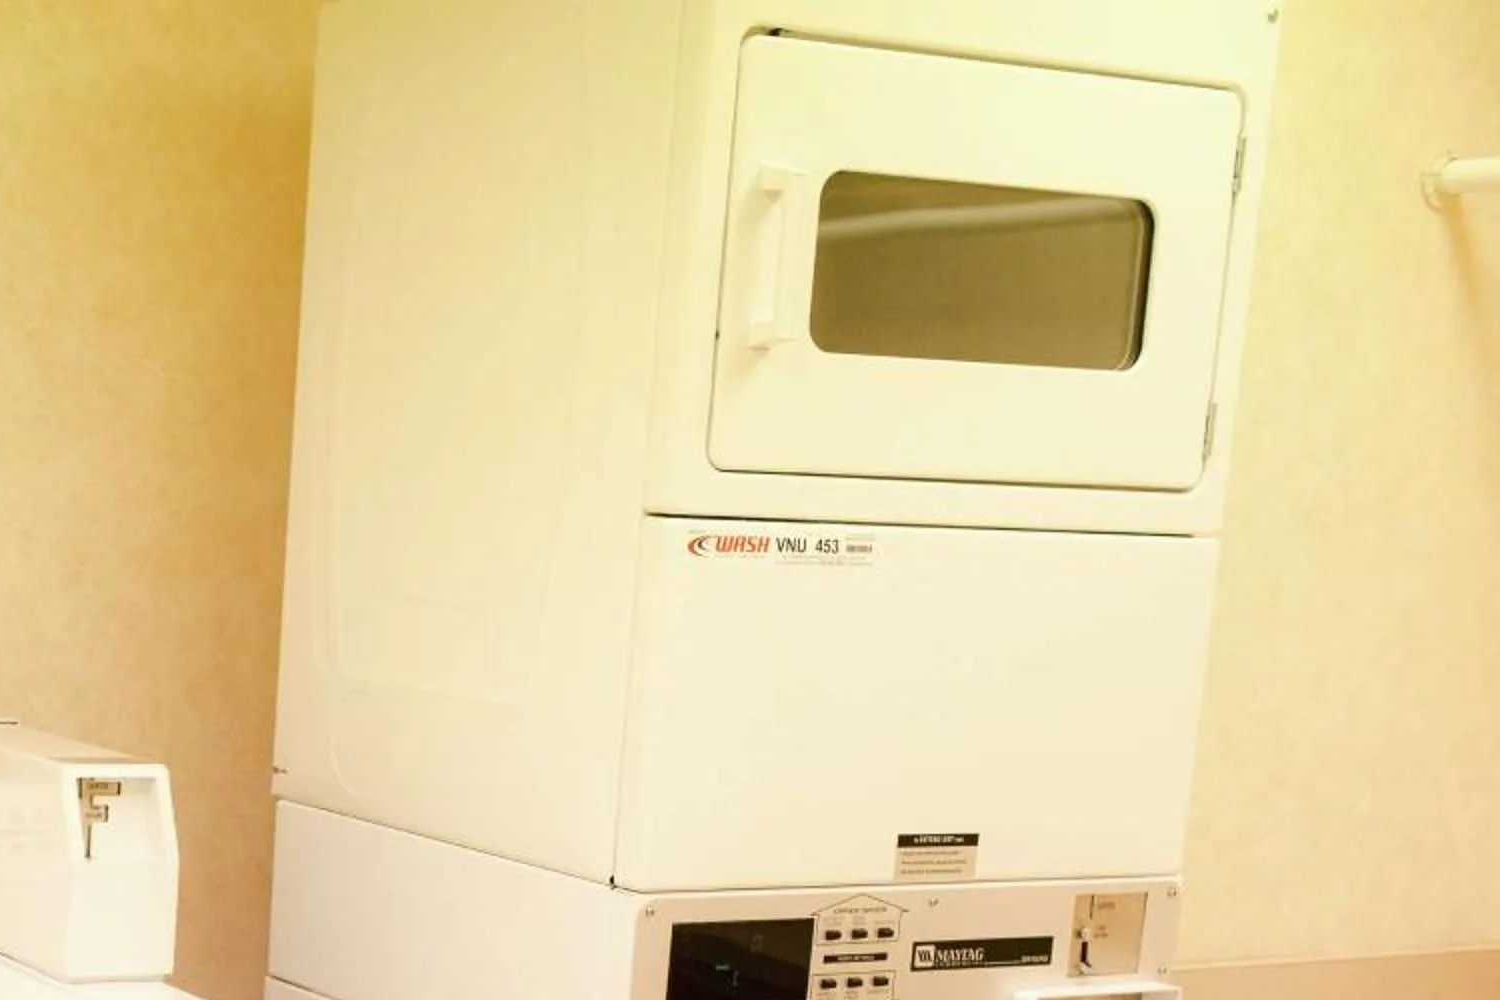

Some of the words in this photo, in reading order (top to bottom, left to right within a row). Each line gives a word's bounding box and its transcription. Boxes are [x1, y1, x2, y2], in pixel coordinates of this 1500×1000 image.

[714, 535, 771, 554] WASH
[775, 536, 808, 554] VNU
[815, 537, 840, 554] 453
[933, 947, 985, 963] MAYTAG
